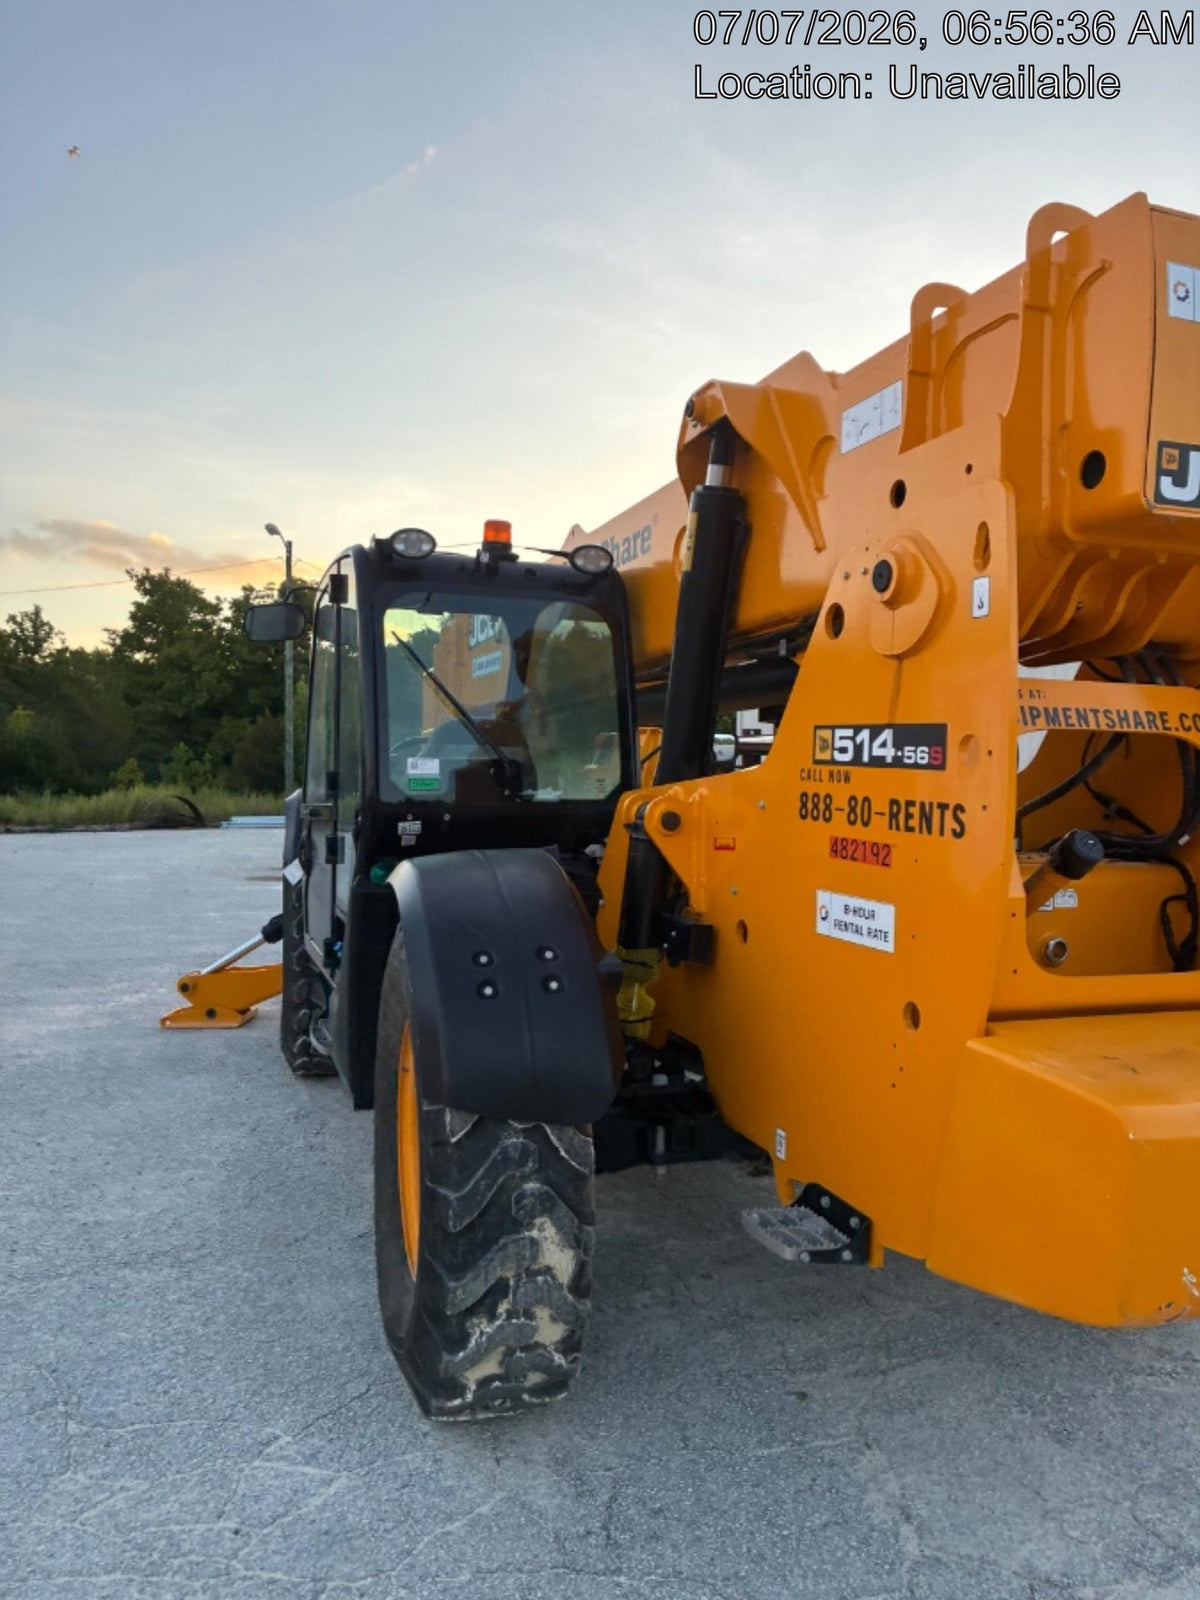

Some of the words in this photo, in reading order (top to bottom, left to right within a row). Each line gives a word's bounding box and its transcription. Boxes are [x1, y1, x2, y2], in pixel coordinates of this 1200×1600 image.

[800, 768, 823, 782] CALL
[829, 769, 851, 784] NOW
[799, 791, 966, 839] 888-80-RENTS
[830, 836, 892, 868] 482192
[833, 918, 864, 936] RENTAL
[867, 926, 889, 942] RATE
